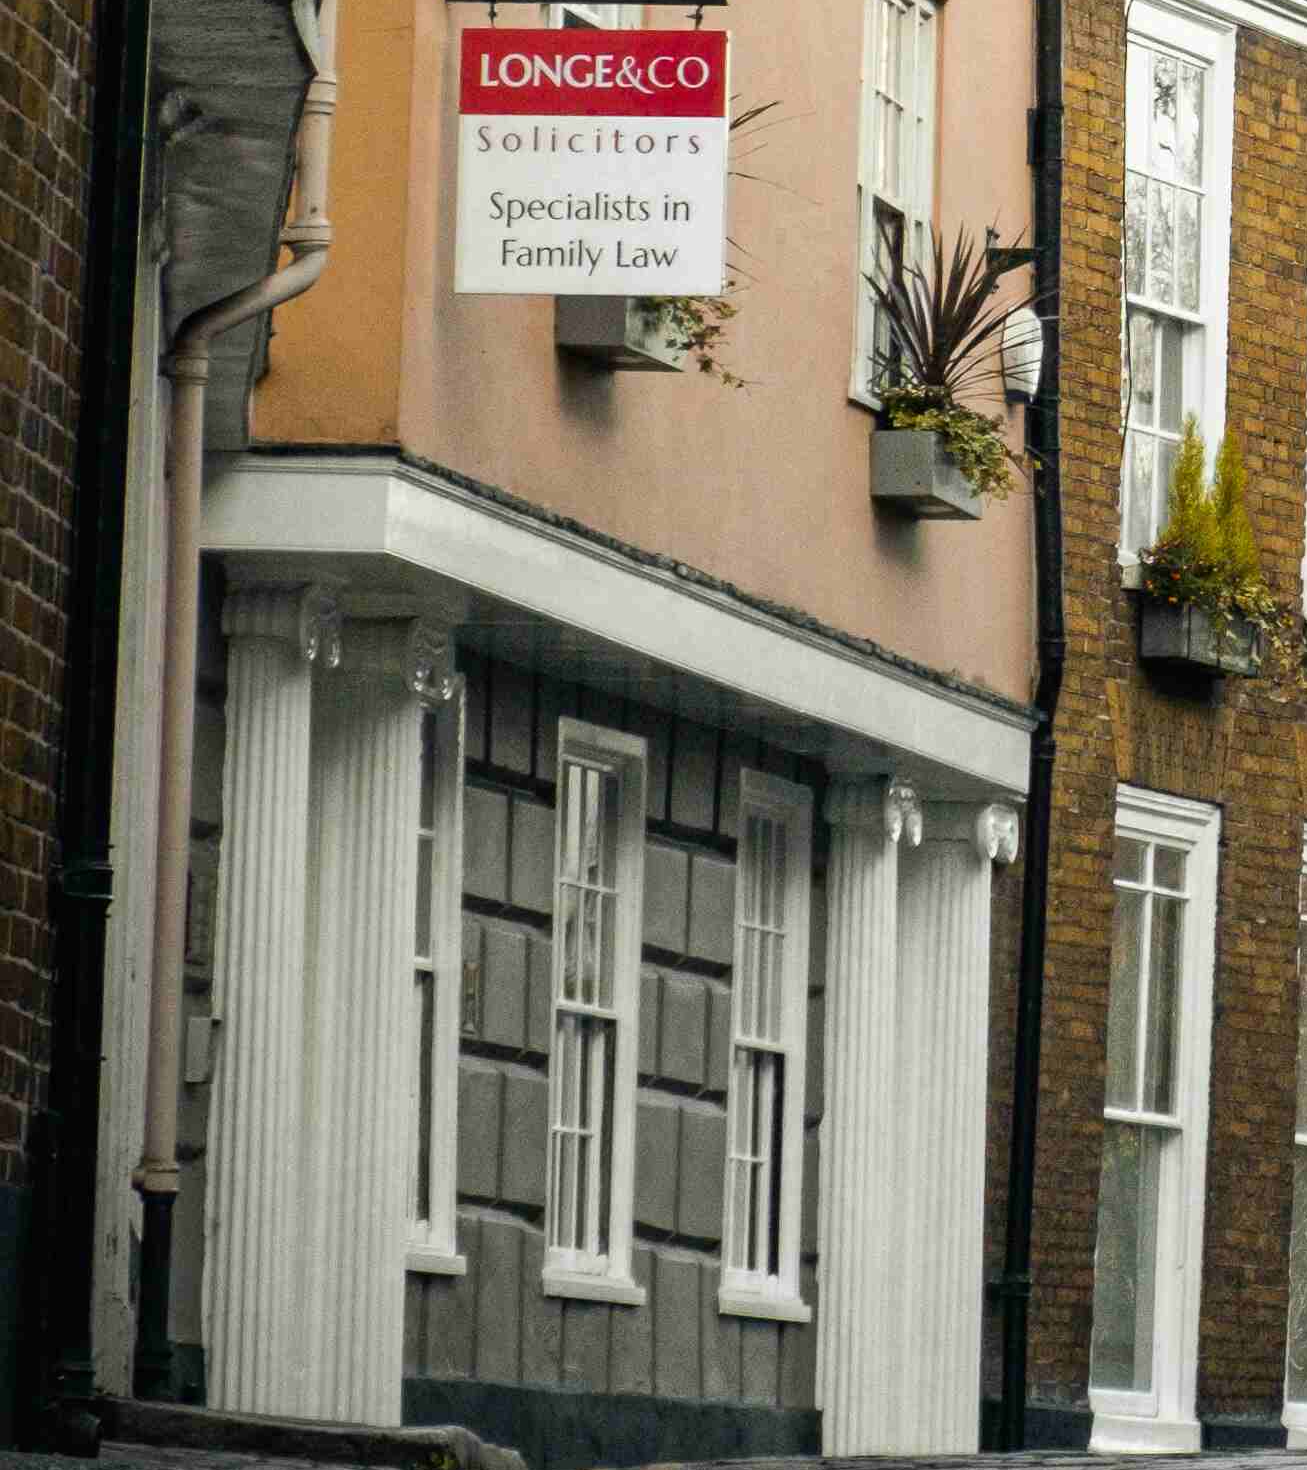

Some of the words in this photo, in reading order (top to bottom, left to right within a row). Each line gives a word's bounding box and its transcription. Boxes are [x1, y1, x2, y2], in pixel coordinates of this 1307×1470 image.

[480, 53, 709, 94] LONGE&CO
[477, 125, 701, 155] Solicitors
[488, 191, 650, 227] Specialists
[663, 194, 690, 221] in
[500, 238, 602, 276] Family
[616, 240, 679, 268] Law
